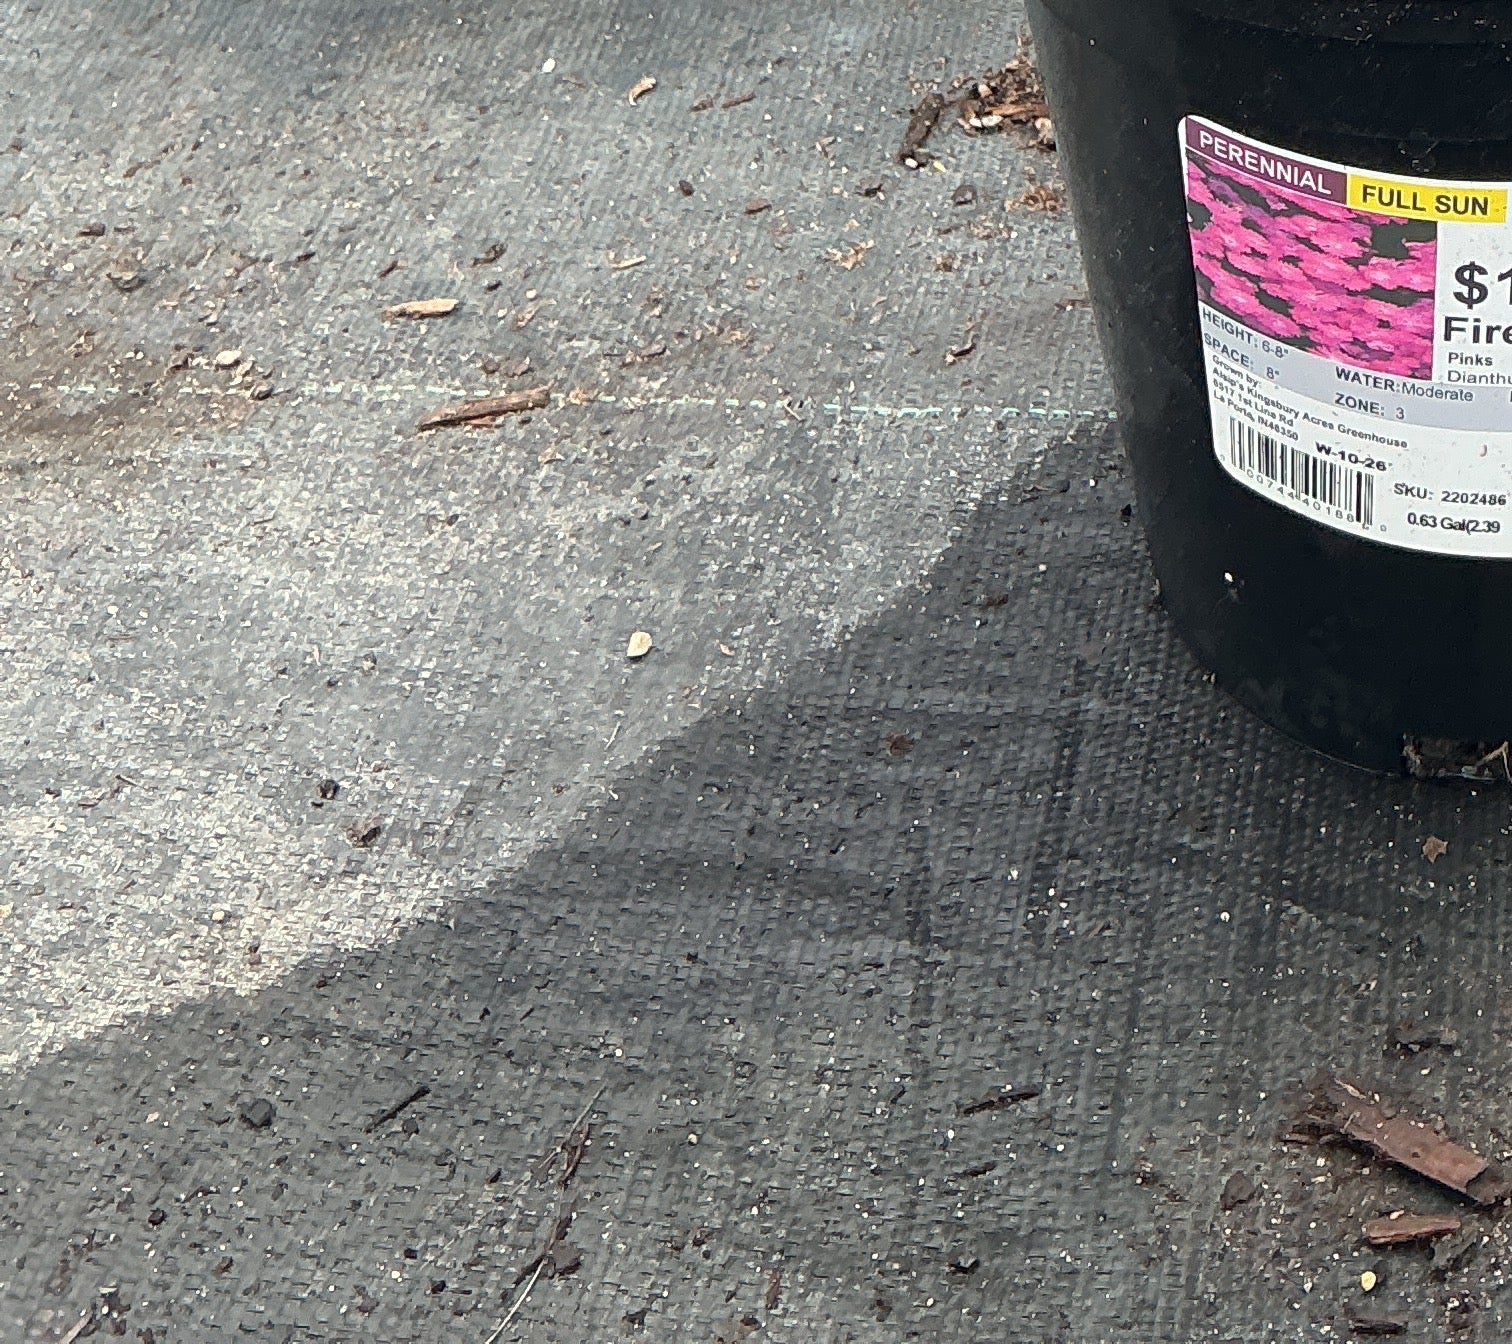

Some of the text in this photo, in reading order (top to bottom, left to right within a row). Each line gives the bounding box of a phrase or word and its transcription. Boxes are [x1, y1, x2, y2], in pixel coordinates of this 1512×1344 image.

[1199, 130, 1332, 195] PERENNIAL
[1362, 184, 1489, 216] FULL SUN
[1203, 308, 1258, 348] HEIGHT:
[1204, 332, 1254, 370] SPACE:
[1448, 352, 1493, 367] Pinks
[1213, 355, 1261, 388] Grown by:
[1214, 390, 1225, 402] La
[1335, 393, 1405, 420] ZONE: 3
[1248, 386, 1299, 419] Kingsbury
[1302, 413, 1334, 429] Acres
[1338, 424, 1407, 448] Greenhouse
[1279, 413, 1293, 427] Rd
[1315, 441, 1386, 471] W-10-26
[1394, 483, 1506, 505] SKU: 2202486
[1407, 512, 1437, 528] 0.63
